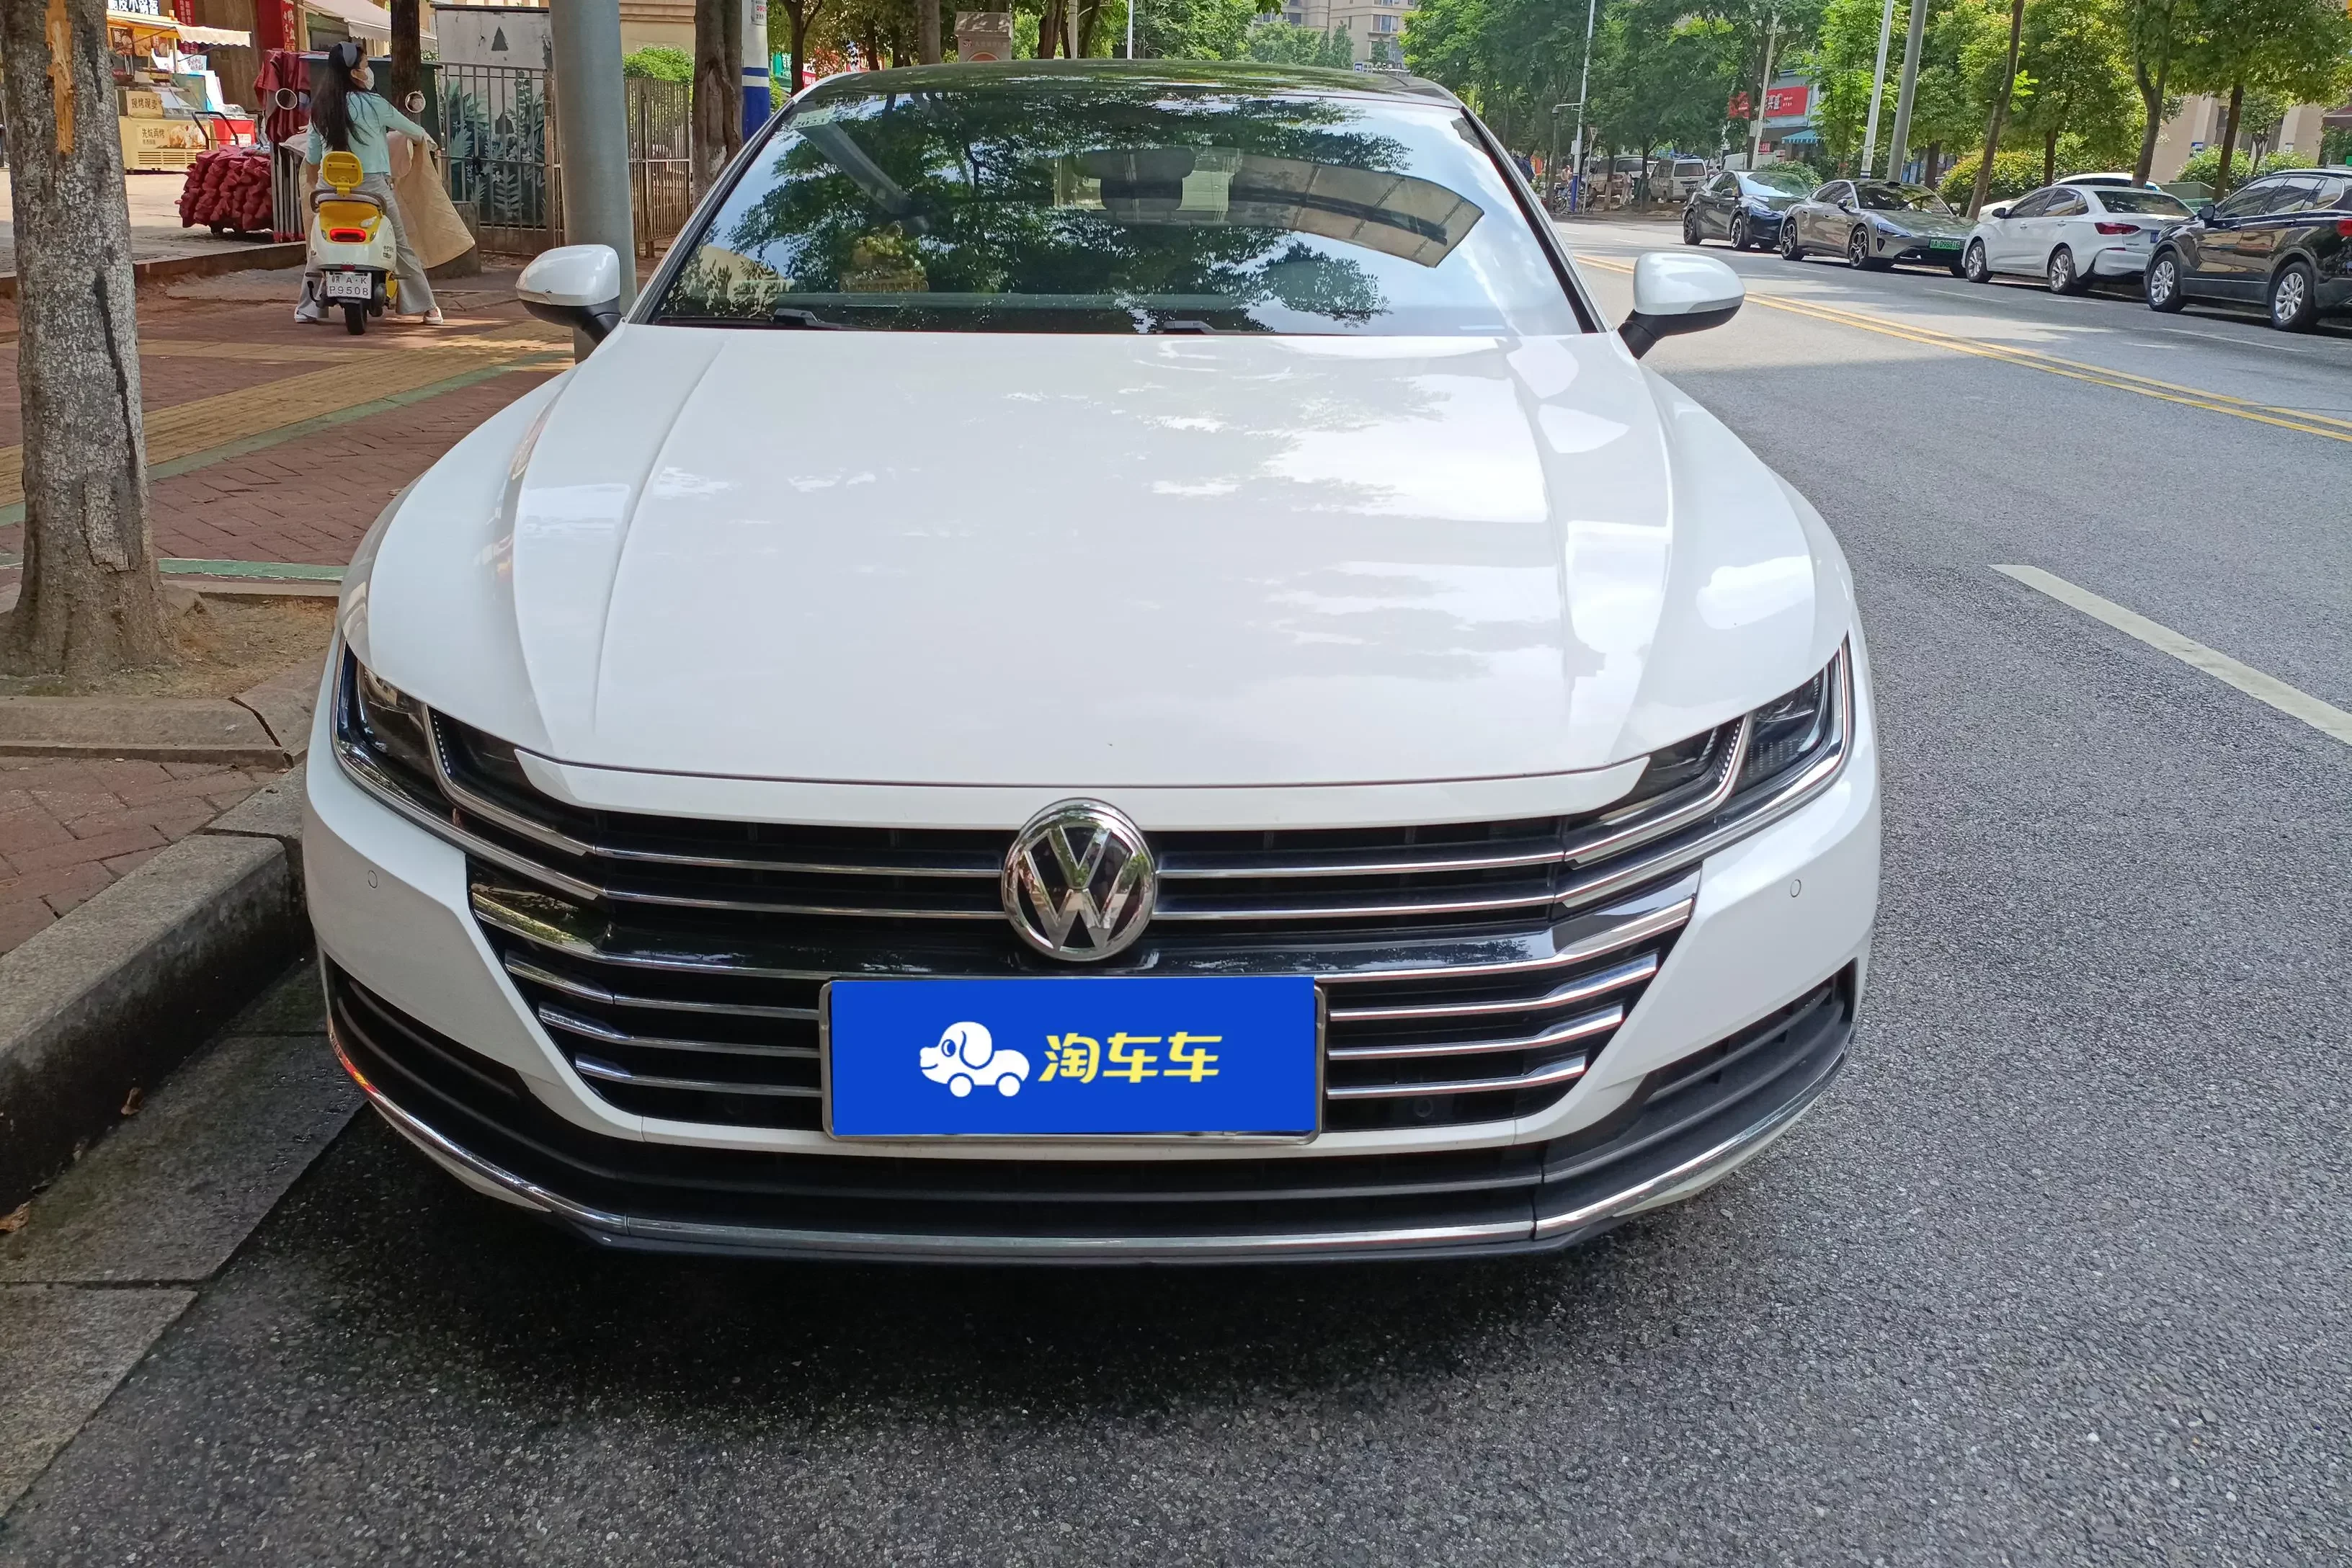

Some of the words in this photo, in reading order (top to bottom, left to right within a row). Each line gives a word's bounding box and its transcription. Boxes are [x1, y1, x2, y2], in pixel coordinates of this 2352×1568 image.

[131, 97, 158, 110] 现烤现卖
[329, 285, 368, 296] P9508
